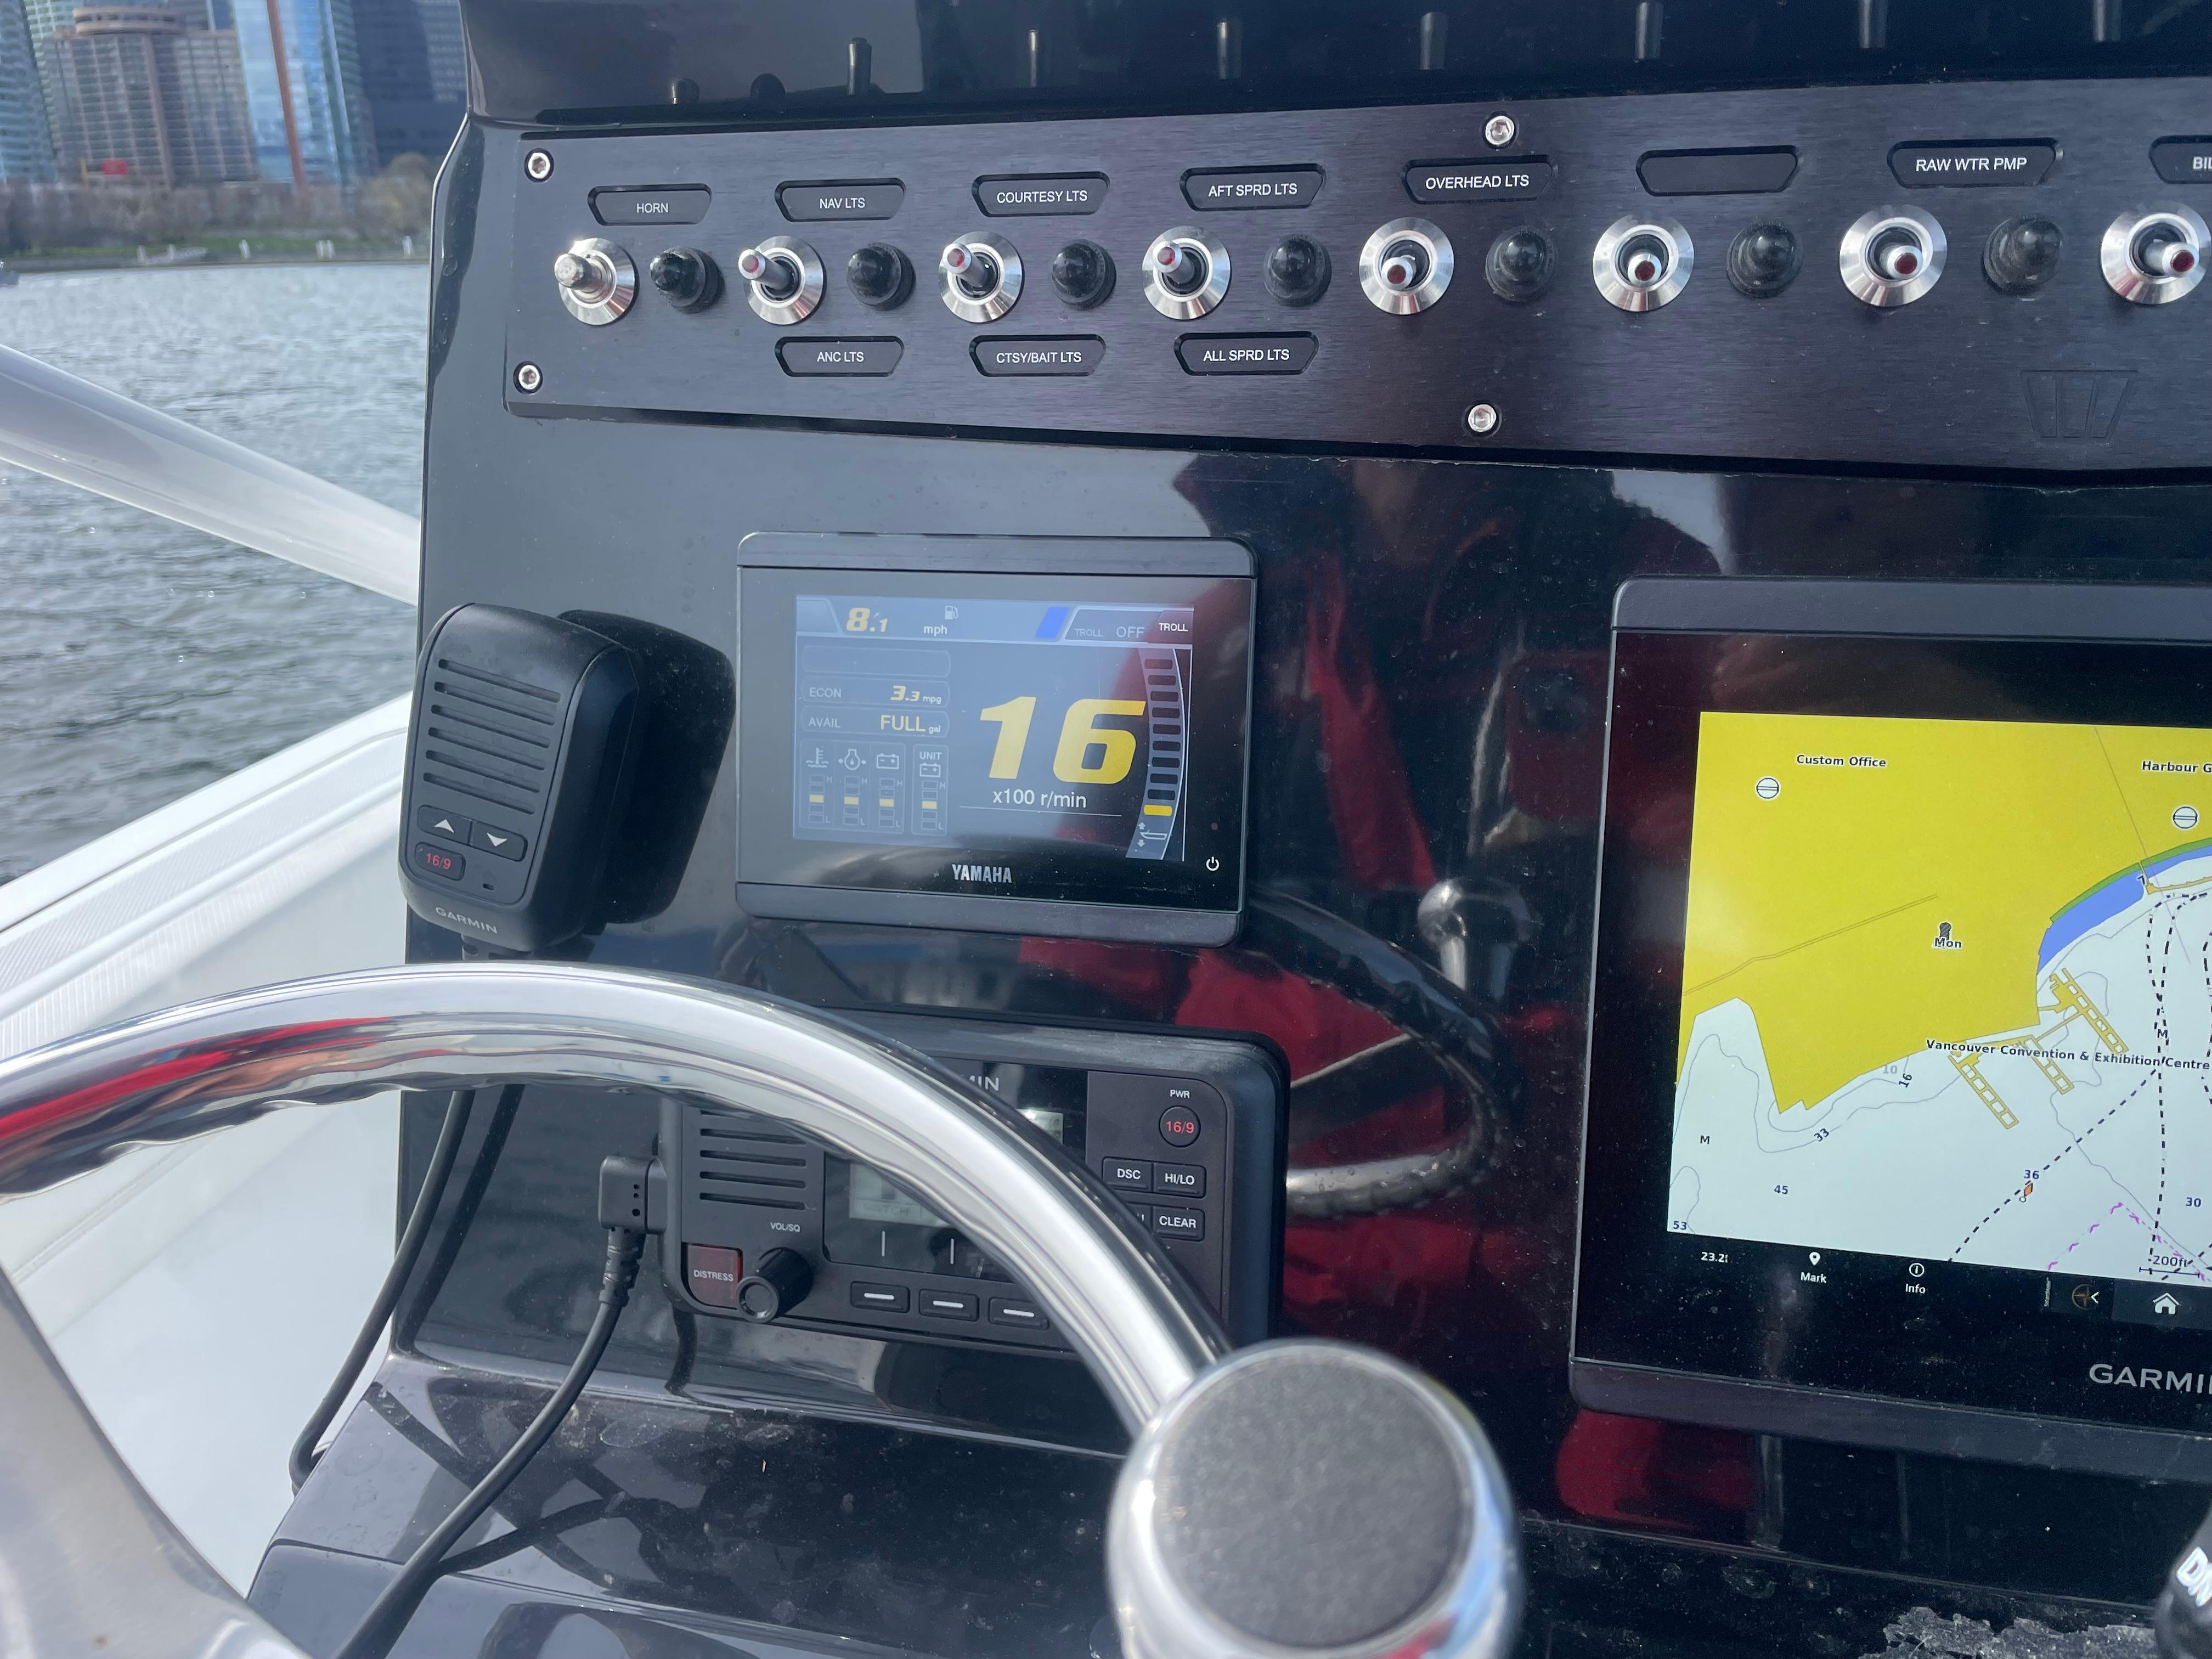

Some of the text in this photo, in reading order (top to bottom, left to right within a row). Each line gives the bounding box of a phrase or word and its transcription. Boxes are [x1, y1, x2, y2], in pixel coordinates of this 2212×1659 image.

[1916, 157, 2027, 172] RAW WTR PMP
[1426, 175, 1529, 189] OVERHEAD LTS
[1208, 183, 1297, 197] AFT SPRD LTS
[997, 190, 1087, 204] COURTESY LTS
[636, 203, 669, 213] HORN
[820, 198, 865, 209] NAV LTS
[817, 352, 864, 363] ANC LTS
[996, 352, 1081, 364] CTSY/BAIT LTS
[1203, 348, 1289, 362] ALL SPRD LTS
[847, 608, 888, 632] 8.1
[924, 625, 947, 636] mph
[1075, 627, 1145, 638] TROLL OFF
[1159, 623, 1188, 631] TROLL
[809, 687, 842, 698] ECON
[891, 685, 941, 704] 3.3 mpg
[809, 718, 841, 729] AVAIL
[881, 715, 941, 735] FULL gal
[980, 696, 1146, 785] 16
[919, 752, 942, 760] UNIT
[1797, 754, 1886, 767] Custom Office
[2142, 761, 2212, 772] Harbour G
[993, 789, 1087, 808] x100 r/min
[426, 853, 452, 870] 16/9
[952, 864, 1012, 883] YAMAHA
[436, 907, 498, 934] GARMIN
[1934, 938, 1962, 948] Mon
[2157, 1029, 2168, 1039] M
[1926, 1039, 2210, 1069] Vancouver Convention & Exhibition Centre
[1882, 1065, 1898, 1074] 10
[1899, 1073, 1912, 1088] 16
[1170, 1089, 1190, 1099] PWR
[1166, 1120, 1195, 1135] 16/9
[1700, 1135, 1710, 1144] M
[1814, 1127, 1830, 1142] 33
[1117, 1168, 1141, 1180] DSC
[1165, 1173, 1195, 1186] HI/LO
[2023, 1170, 2039, 1180] 36
[1774, 1185, 1789, 1195] 45
[2185, 1197, 2202, 1207] 30
[770, 1222, 800, 1233] VOL/SQ
[1159, 1216, 1197, 1228] CLEAR
[1672, 1221, 1688, 1231] 53
[2153, 1255, 2188, 1267] 200ft
[693, 1269, 734, 1282] DISTRESS
[1801, 1272, 1827, 1284] Mark
[1905, 1284, 1926, 1294] Info
[2089, 1363, 2212, 1395] GARMI
